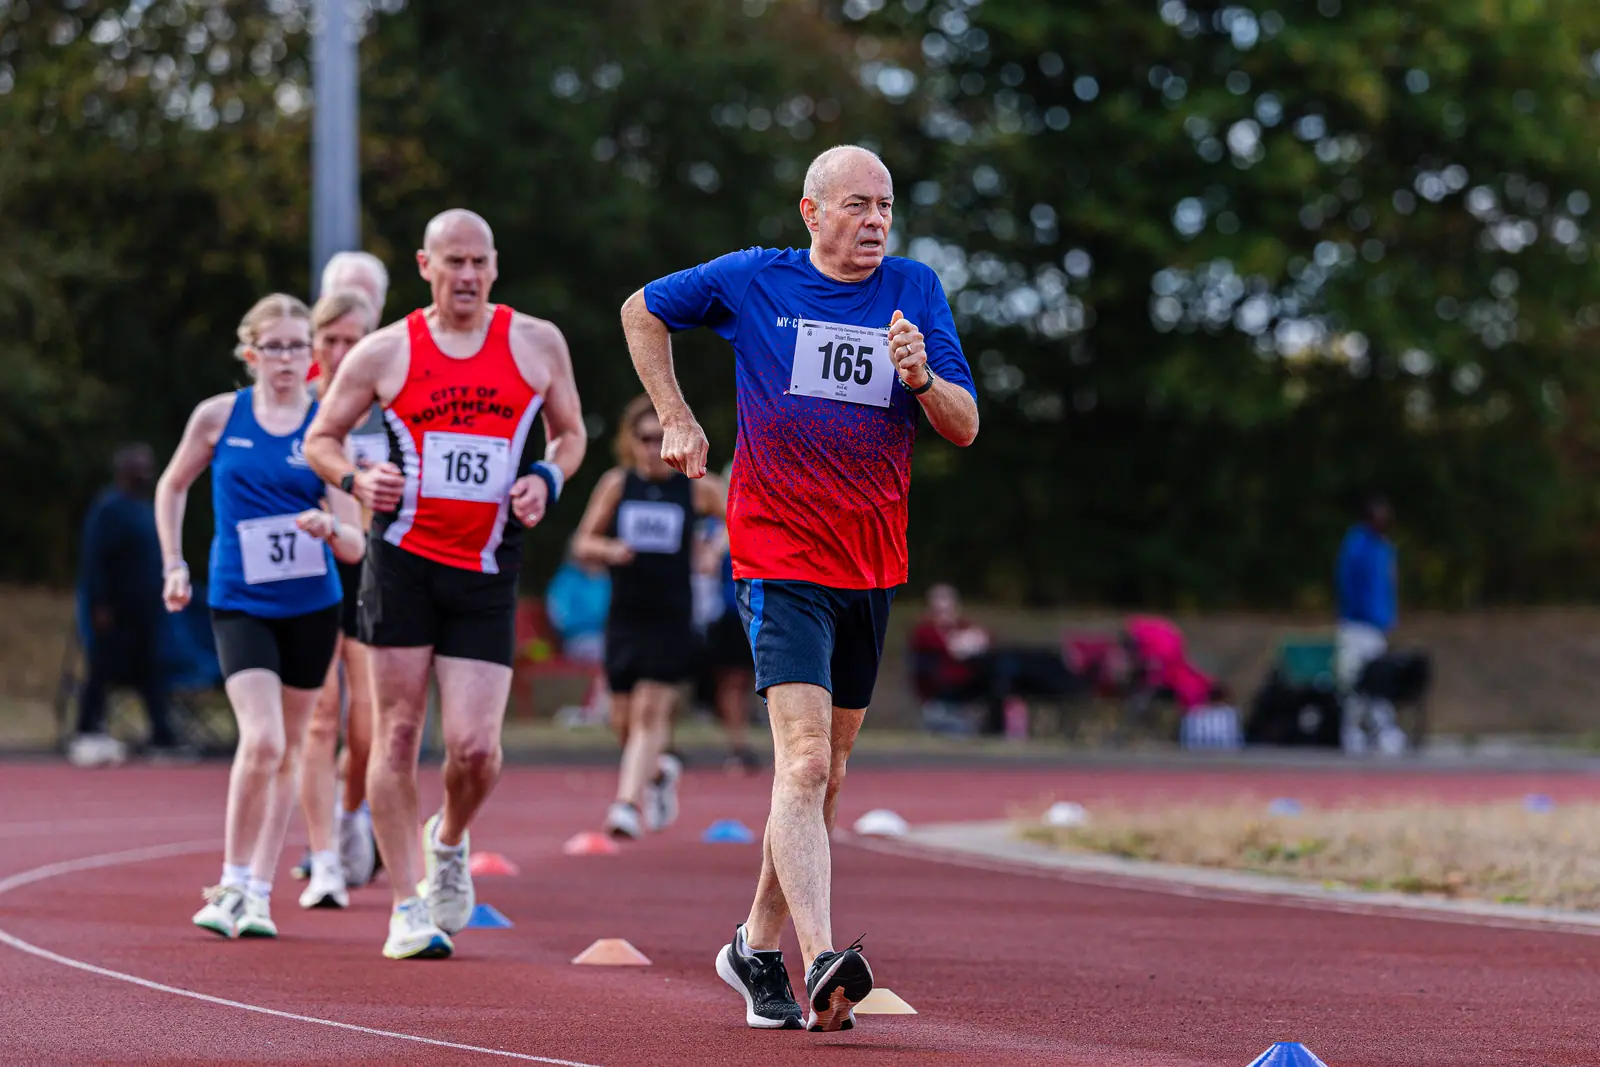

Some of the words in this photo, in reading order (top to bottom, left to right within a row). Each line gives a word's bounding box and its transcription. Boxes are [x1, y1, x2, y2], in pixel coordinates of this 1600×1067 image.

[818, 341, 874, 386] 165
[430, 387, 470, 402] CITY
[476, 387, 498, 398] OF
[411, 400, 514, 425] SOUTHEND
[450, 415, 476, 427] AC
[442, 451, 491, 485] 163
[267, 532, 297, 563] 37
